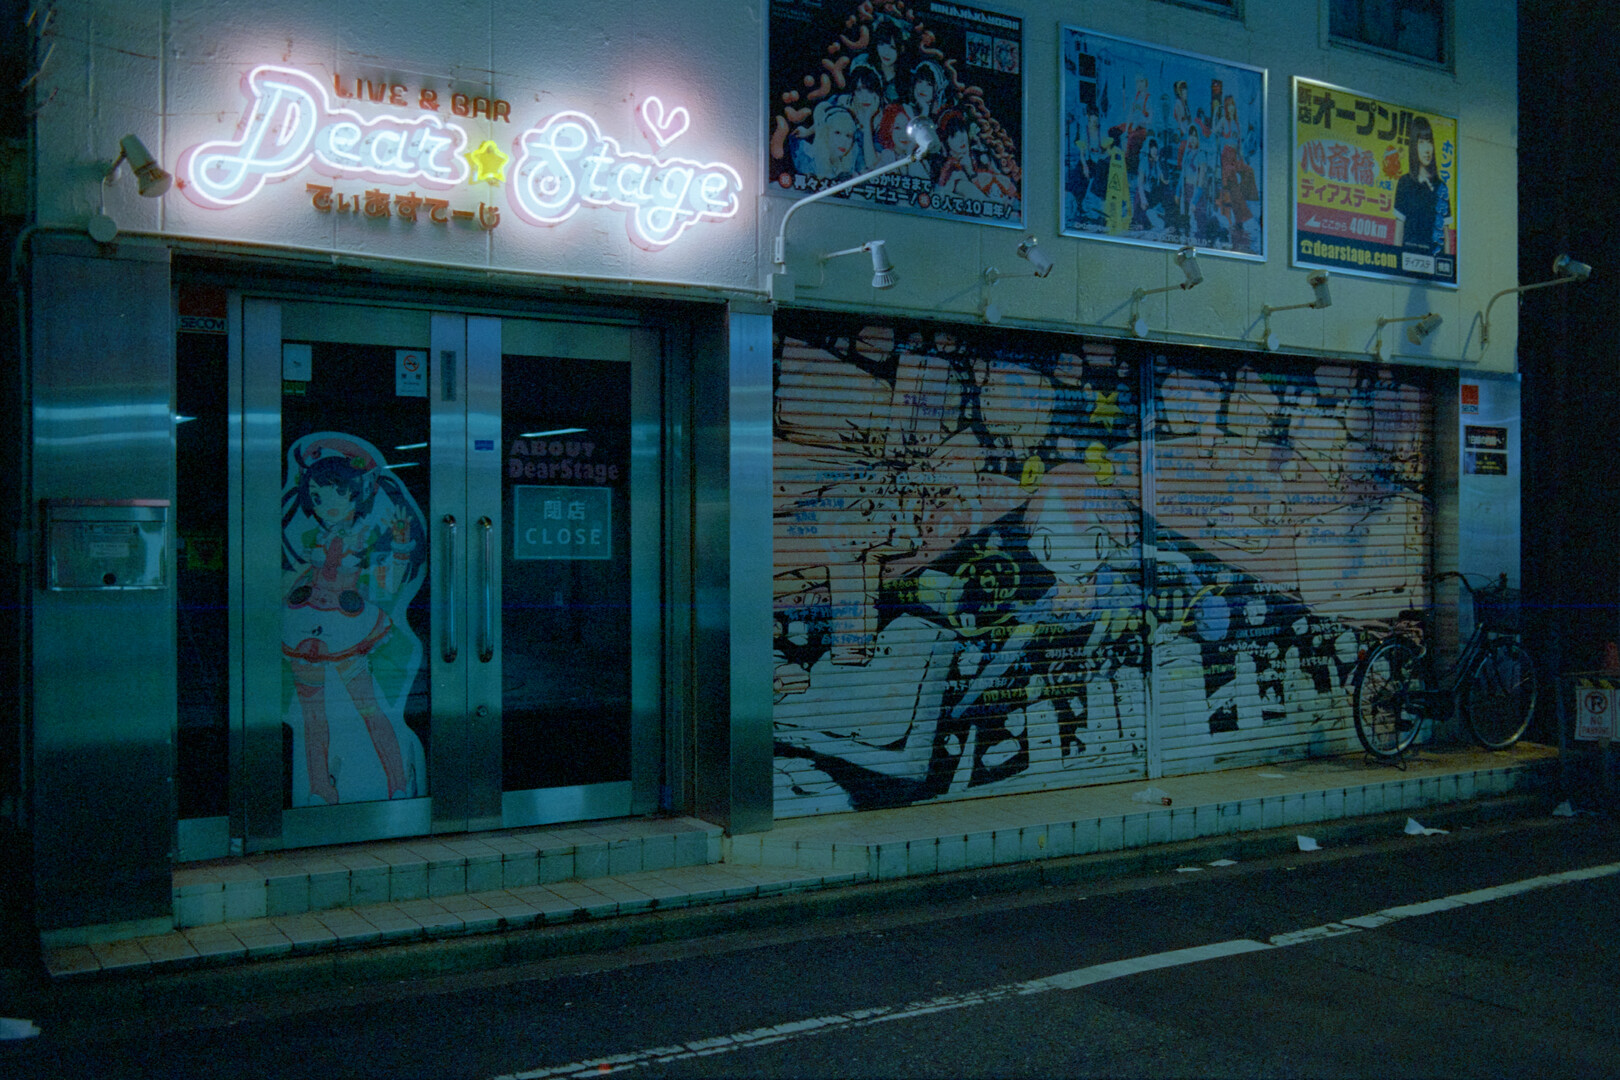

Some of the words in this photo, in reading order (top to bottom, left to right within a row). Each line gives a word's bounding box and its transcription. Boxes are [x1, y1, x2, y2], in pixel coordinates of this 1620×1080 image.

[333, 73, 409, 108] LIVE
[418, 83, 439, 111] &
[450, 93, 512, 123] BAR
[186, 65, 468, 206] Dear
[517, 111, 743, 248] Stage
[1301, 141, 1375, 187] 心斎橋
[1301, 178, 1392, 212] ディアステージ
[1350, 217, 1387, 239] 400km
[1314, 241, 1397, 268] dearstage.com
[181, 317, 225, 330] SECOM
[509, 440, 596, 458] ABOUT
[508, 458, 620, 484] DearStage
[525, 528, 602, 545] CLOSE
